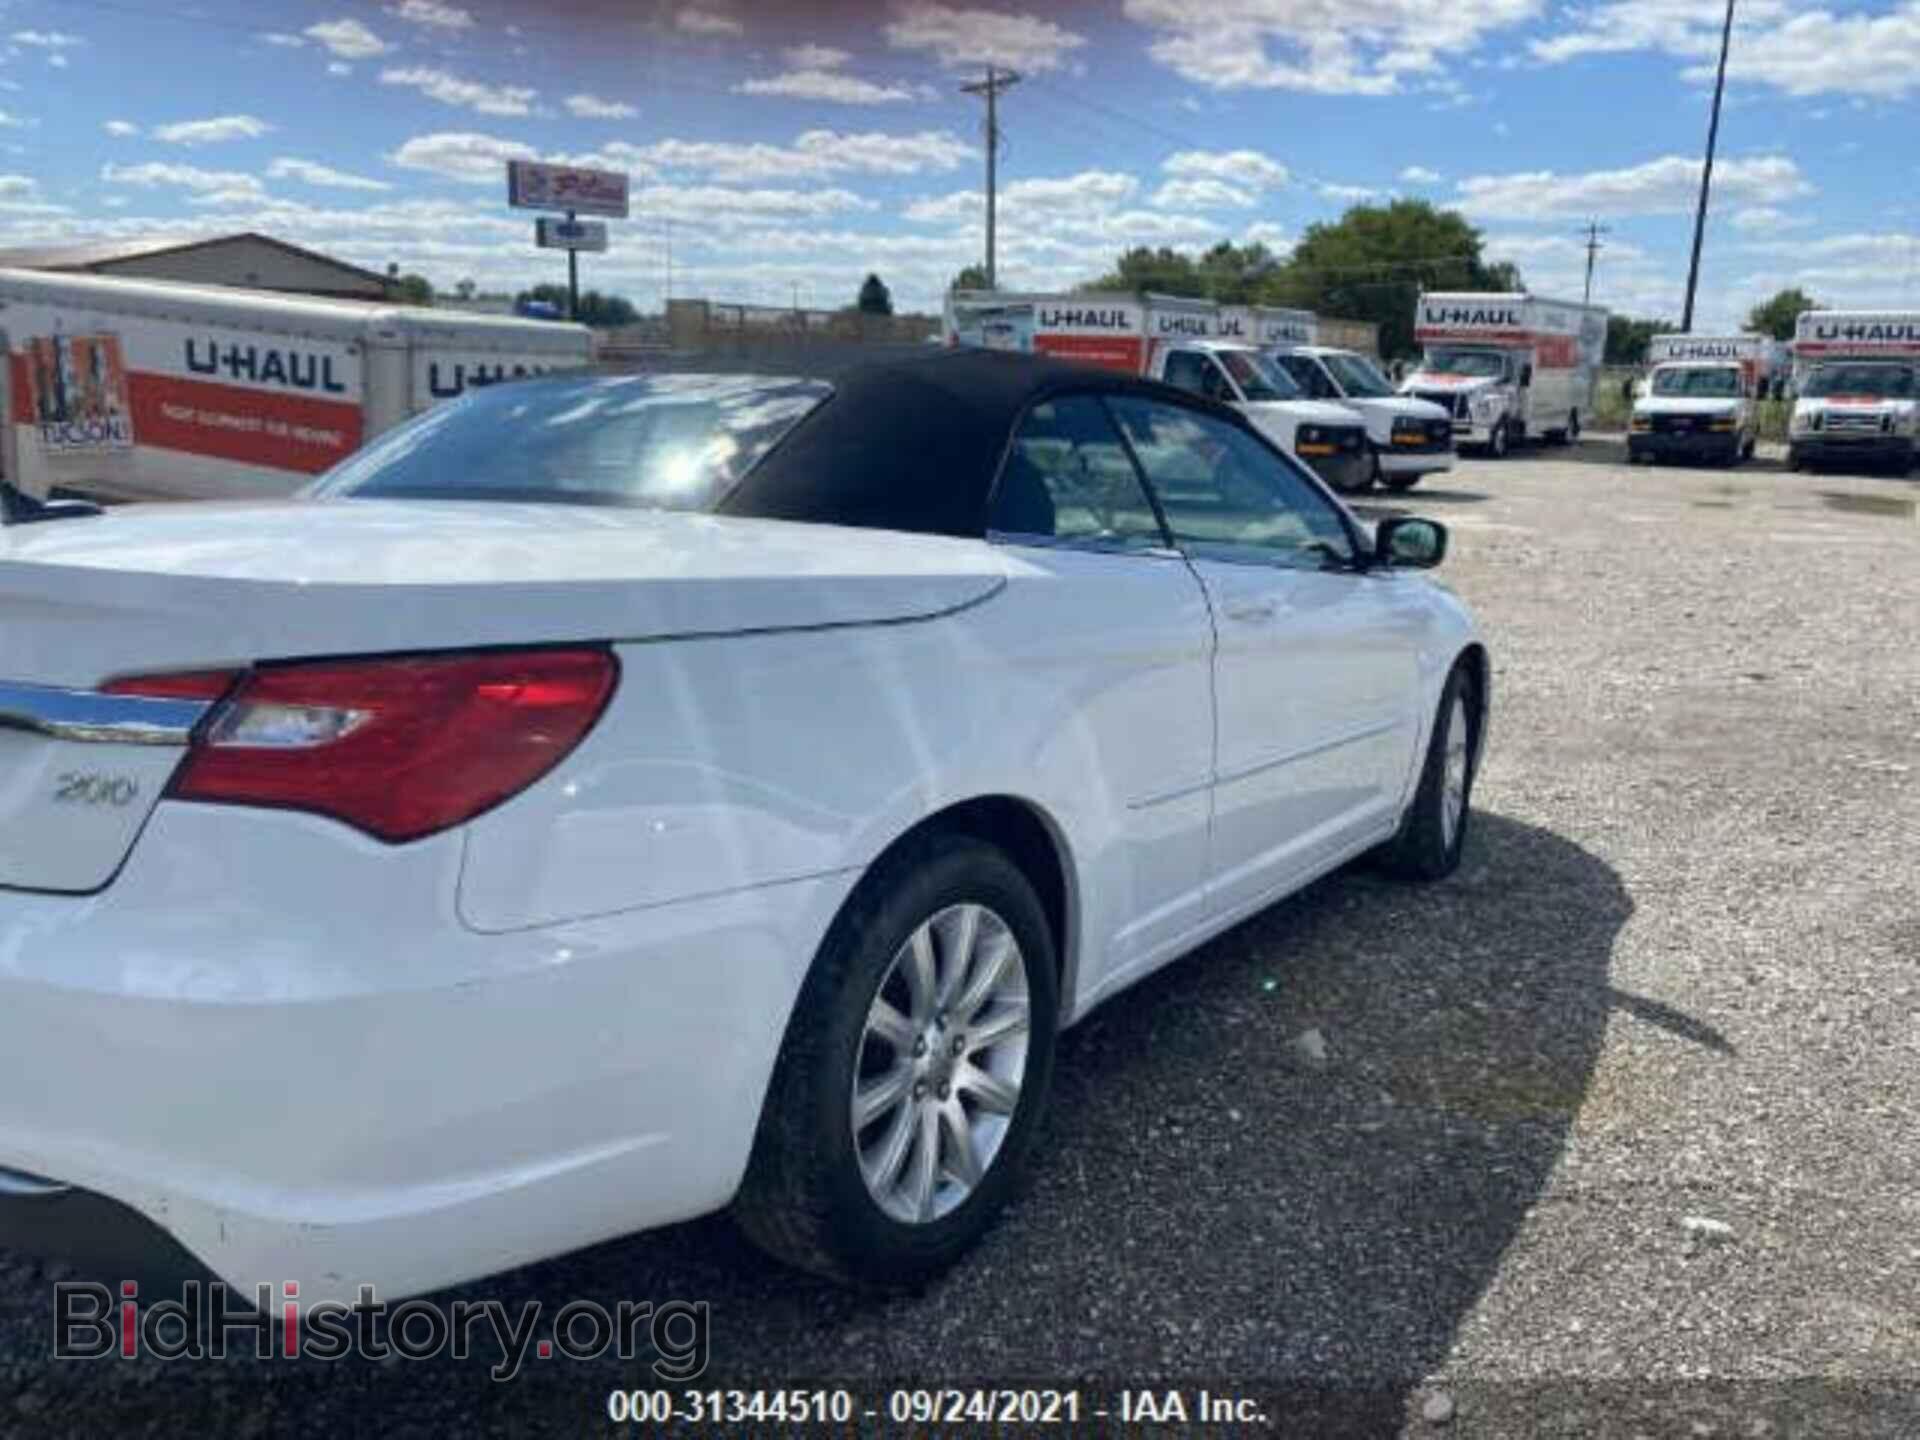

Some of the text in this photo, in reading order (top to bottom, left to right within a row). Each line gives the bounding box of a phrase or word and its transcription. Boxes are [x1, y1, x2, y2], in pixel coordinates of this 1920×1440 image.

[1041, 309, 1131, 330] U-HAUL
[1425, 308, 1520, 325] U-HAUL
[1816, 324, 1920, 339] U-HAUL
[1668, 344, 1742, 357] U-HAUL
[186, 338, 345, 392] U-HAUL
